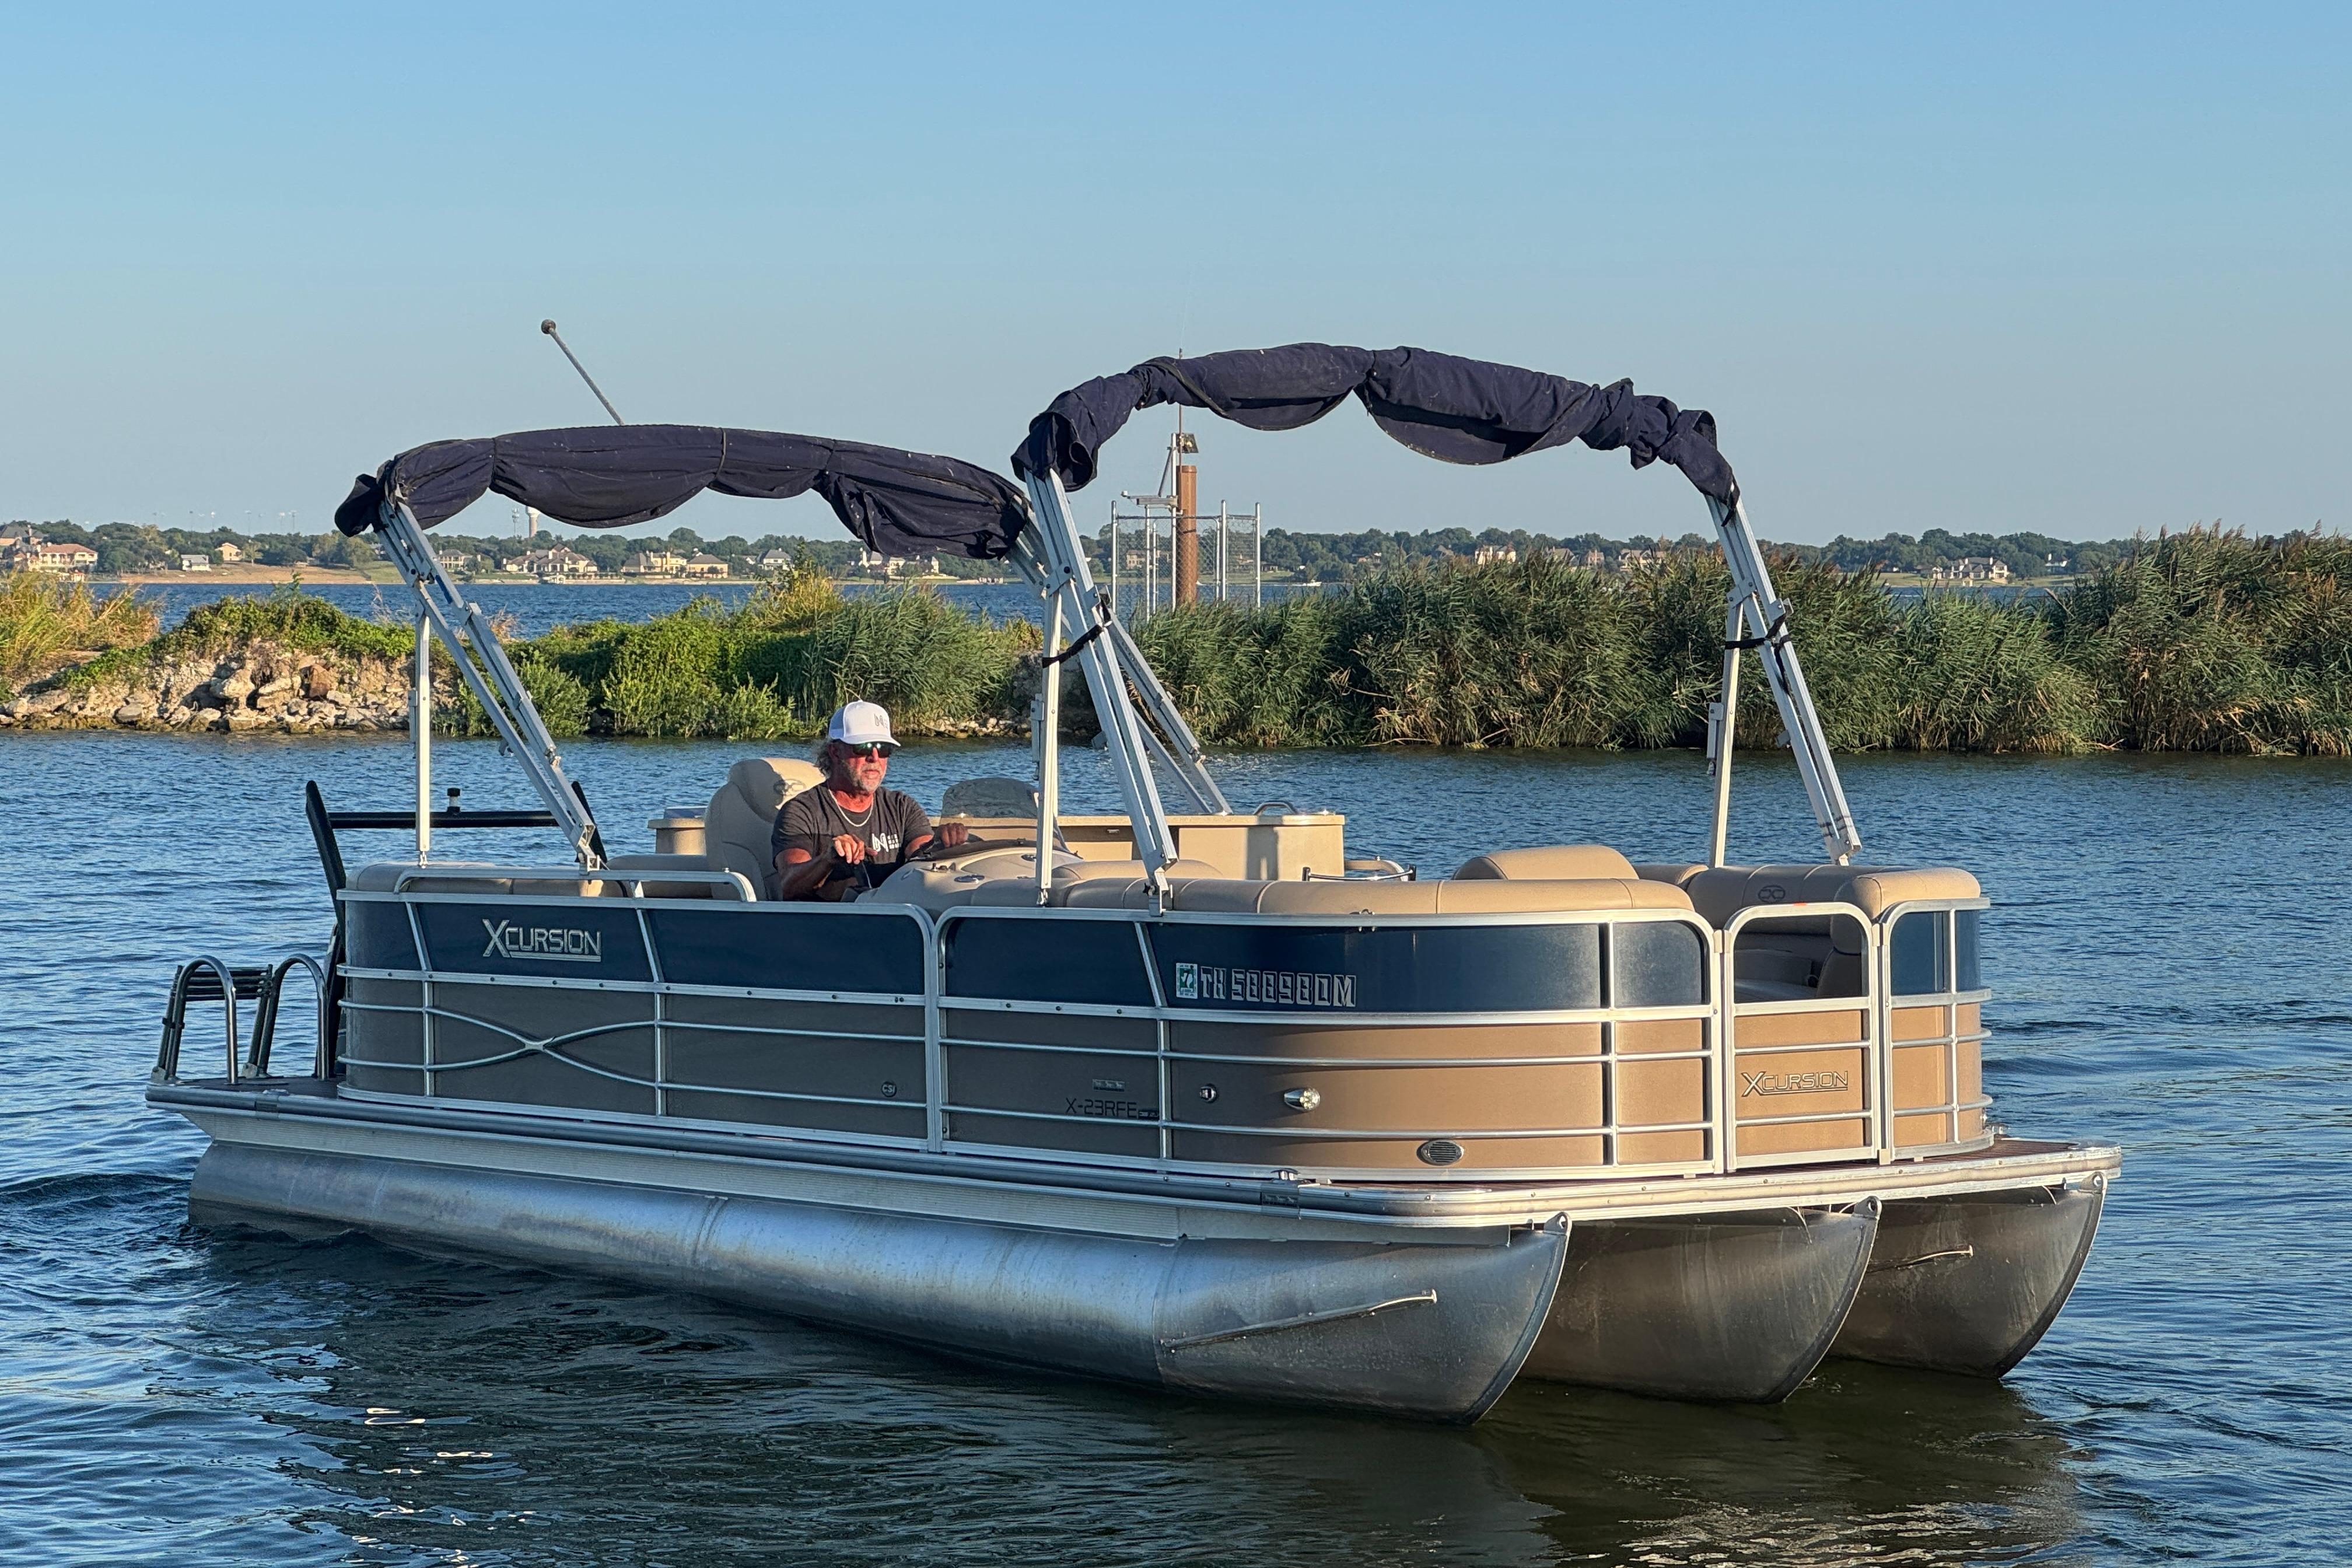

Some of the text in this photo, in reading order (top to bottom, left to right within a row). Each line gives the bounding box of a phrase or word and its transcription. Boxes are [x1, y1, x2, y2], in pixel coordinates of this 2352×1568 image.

[482, 919, 601, 960] XCURSION
[1741, 1070, 1848, 1097] XCURSION
[1066, 1097, 1137, 1118] X-23RFE
